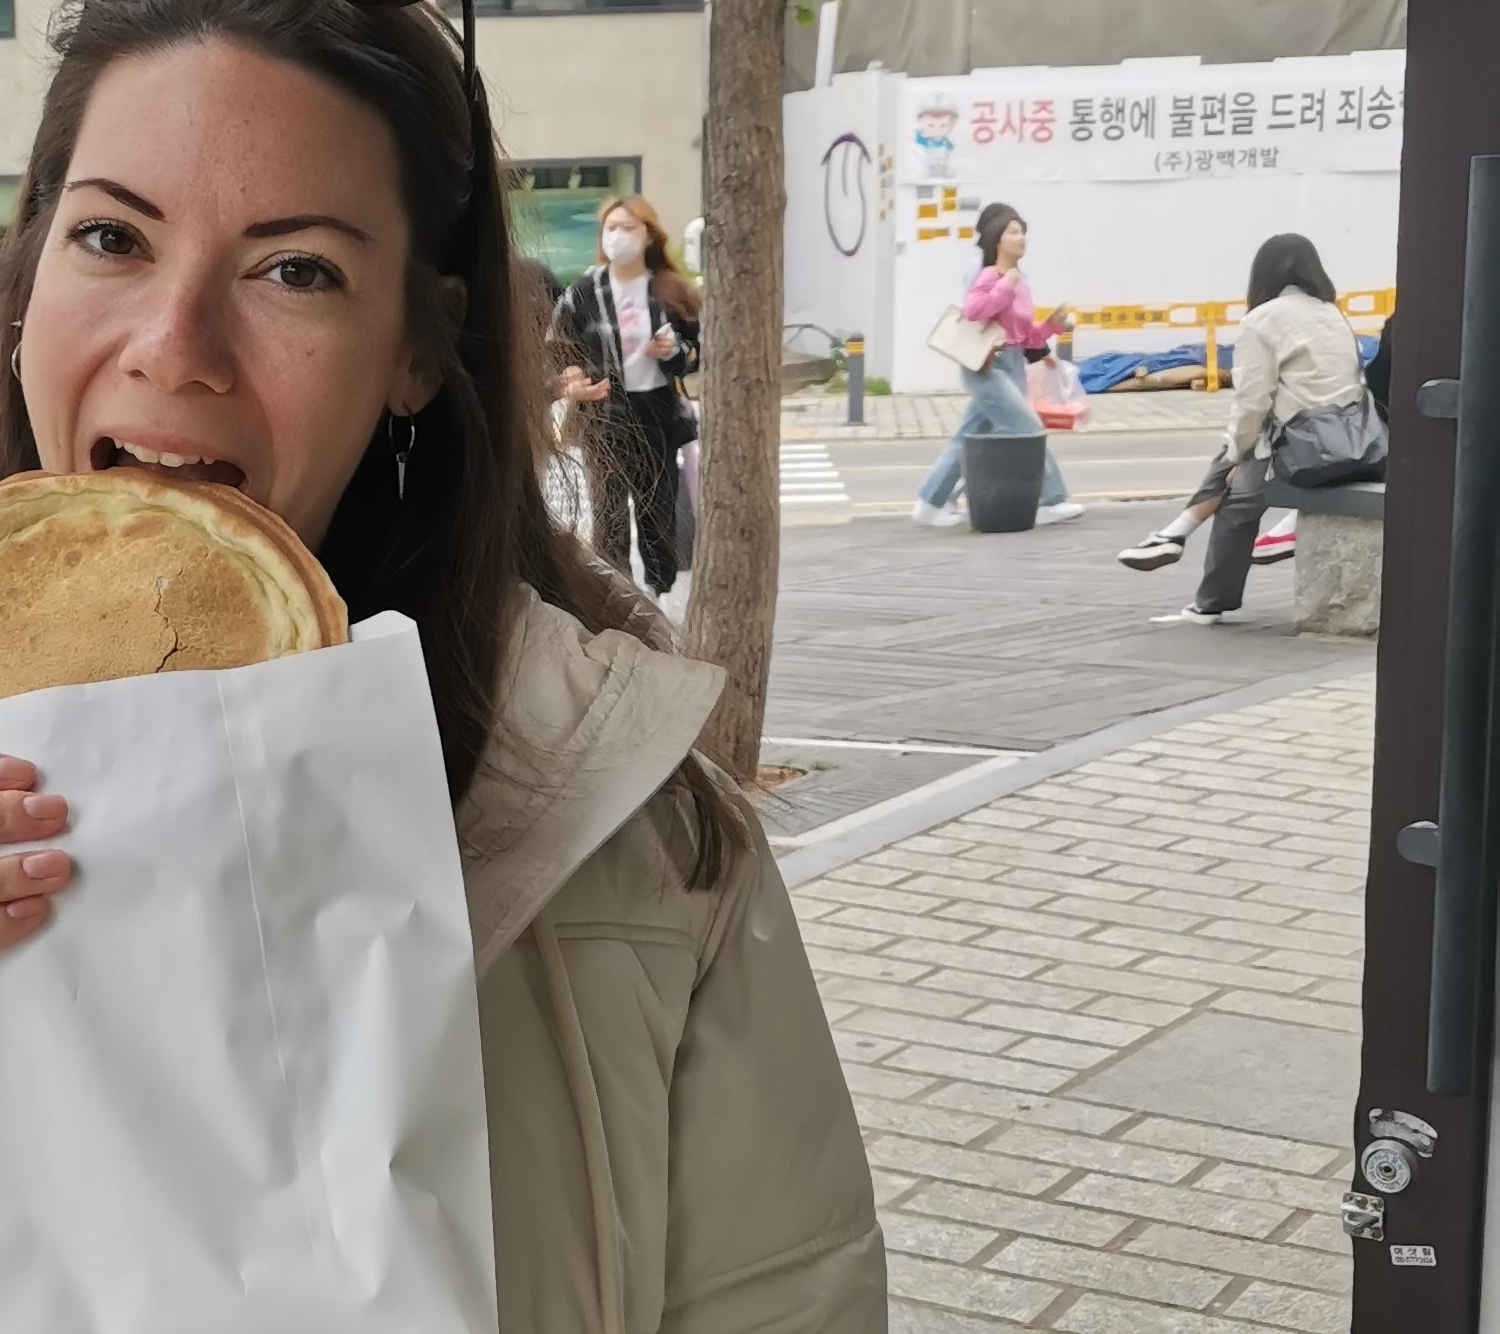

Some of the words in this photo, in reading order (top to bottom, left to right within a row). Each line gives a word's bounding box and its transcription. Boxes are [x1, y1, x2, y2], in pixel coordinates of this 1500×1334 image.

[970, 99, 1057, 144] 공사중
[1068, 96, 1156, 142] 통행에
[1169, 92, 1257, 138] 불편을
[1267, 88, 1326, 132] 드려
[1336, 84, 1405, 131] 죄송
